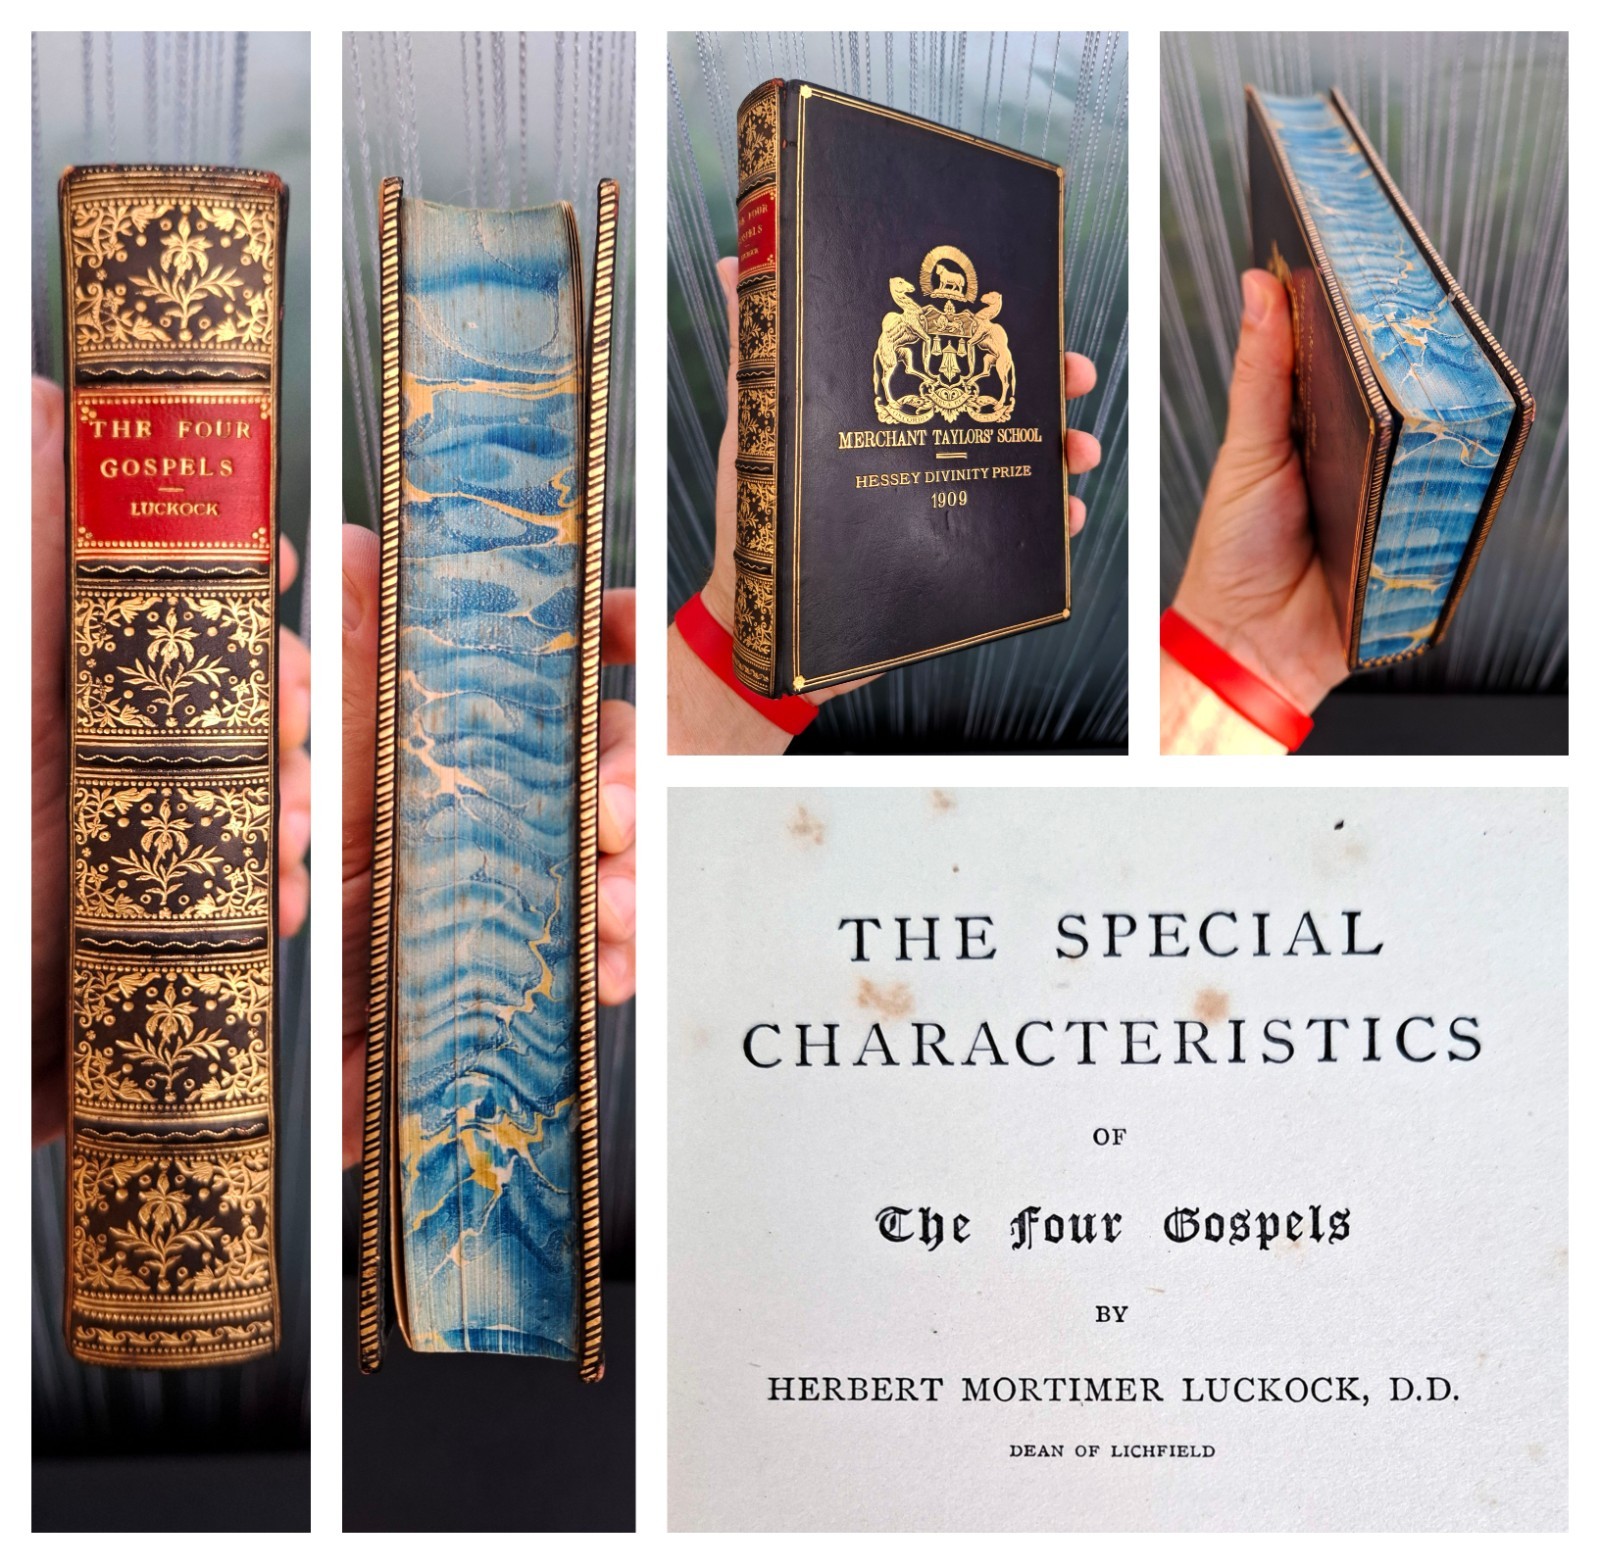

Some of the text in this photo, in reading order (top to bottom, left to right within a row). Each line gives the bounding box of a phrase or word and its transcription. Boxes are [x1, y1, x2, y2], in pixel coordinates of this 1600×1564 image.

[91, 420, 251, 439] THE FOUR
[838, 427, 1042, 450] MERCHANT TAYLORS' SCHOOL
[100, 457, 234, 479] GOSPELS
[855, 465, 1032, 489] HESSEY DIVINITY PRIZE
[130, 501, 220, 517] LUCKOCK
[931, 490, 968, 509] 1909
[837, 911, 1385, 963] THE SPECIAL
[742, 1016, 1484, 1069] CHARACTERISTICS
[1092, 1127, 1128, 1147] OF
[876, 1204, 1352, 1252] The Four Gospels
[1095, 1305, 1129, 1324] BY
[767, 1376, 1461, 1408] HERBERT MORTIMER LUCKOCK, D.D.
[1009, 1444, 1217, 1459] DEAN OF LICHFIELD
